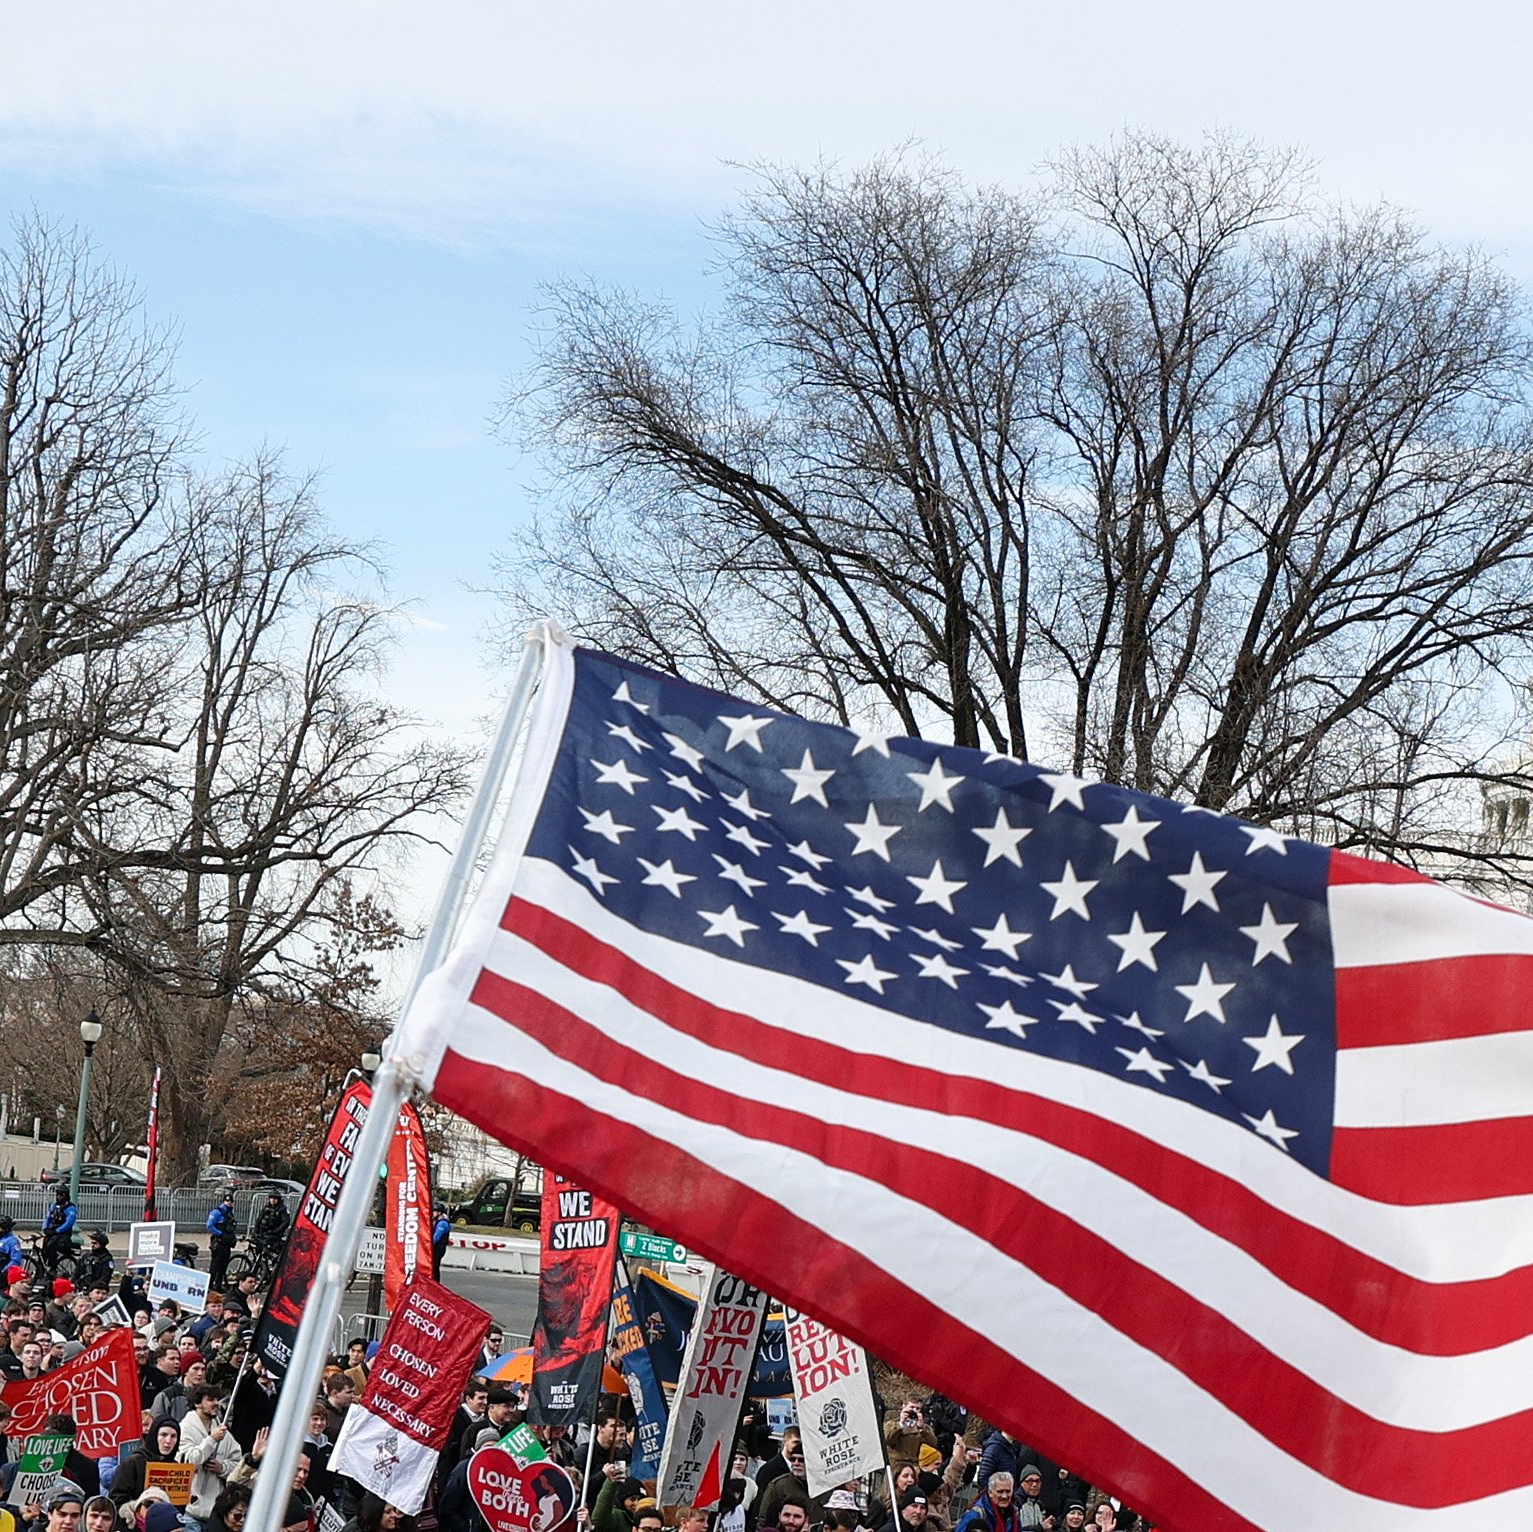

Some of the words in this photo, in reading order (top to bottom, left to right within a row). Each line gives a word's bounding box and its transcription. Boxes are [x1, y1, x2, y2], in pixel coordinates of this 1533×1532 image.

[345, 1096, 358, 1114] IN
[324, 1144, 333, 1161] OF
[317, 1169, 342, 1205] WE
[399, 1181, 407, 1199] FOR
[303, 1192, 336, 1233] STAN
[558, 1191, 591, 1218] WE
[397, 1200, 406, 1243] STANDING
[372, 1232, 385, 1240] NO
[553, 1220, 607, 1250] STAND
[641, 1240, 647, 1251] 2
[648, 1240, 667, 1255] Blocks
[409, 1292, 444, 1320] EVERY
[613, 1294, 634, 1326] BE
[403, 1310, 446, 1342] PERSON
[267, 1342, 287, 1362] ROSE
[269, 1333, 293, 1358] WHITE
[389, 1344, 438, 1379] CHOSEN
[379, 1368, 420, 1399] LOVED
[795, 1349, 860, 1401] ION!
[11, 1360, 118, 1419] CHOSEN
[550, 1384, 579, 1395] WHITE
[371, 1394, 436, 1439] NECESSARY
[27, 1439, 54, 1456] LOVE
[53, 1438, 74, 1453] LIFE
[509, 1430, 535, 1452] LIFE
[819, 1436, 860, 1460] WHITE
[823, 1456, 861, 1476] RESISTANCE
[825, 1448, 856, 1468] ROSE
[21, 1473, 57, 1491] CHOOSE
[478, 1466, 522, 1492] LOVE
[482, 1490, 531, 1519] BOTH
